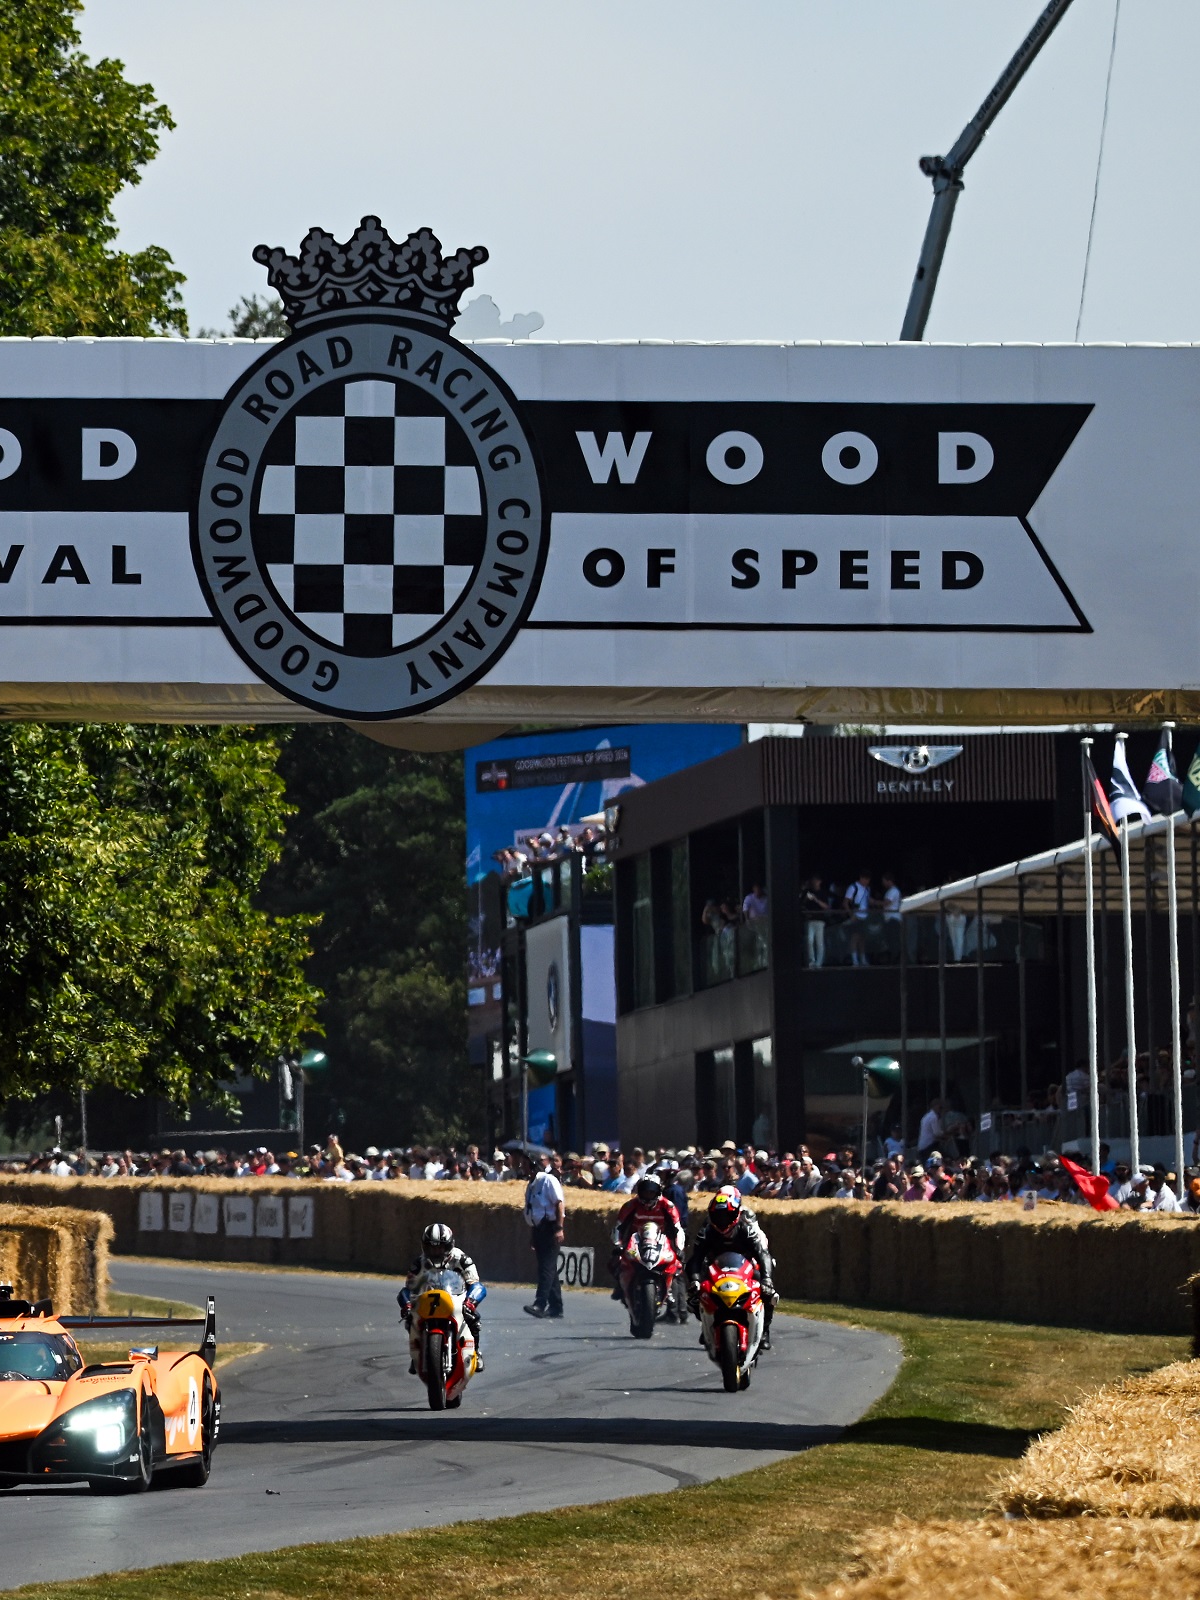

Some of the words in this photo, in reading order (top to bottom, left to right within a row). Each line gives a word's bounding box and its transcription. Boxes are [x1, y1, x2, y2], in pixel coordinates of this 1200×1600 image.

[241, 335, 353, 425] ROAD
[387, 334, 521, 473] RACING
[575, 430, 995, 486] WOOD
[209, 447, 340, 693] GOODWOOD
[405, 497, 531, 696] COMPANY
[582, 547, 676, 589] OF
[730, 547, 985, 591] SPEED
[877, 780, 954, 793] BENTLEY
[427, 1293, 441, 1316] 7
